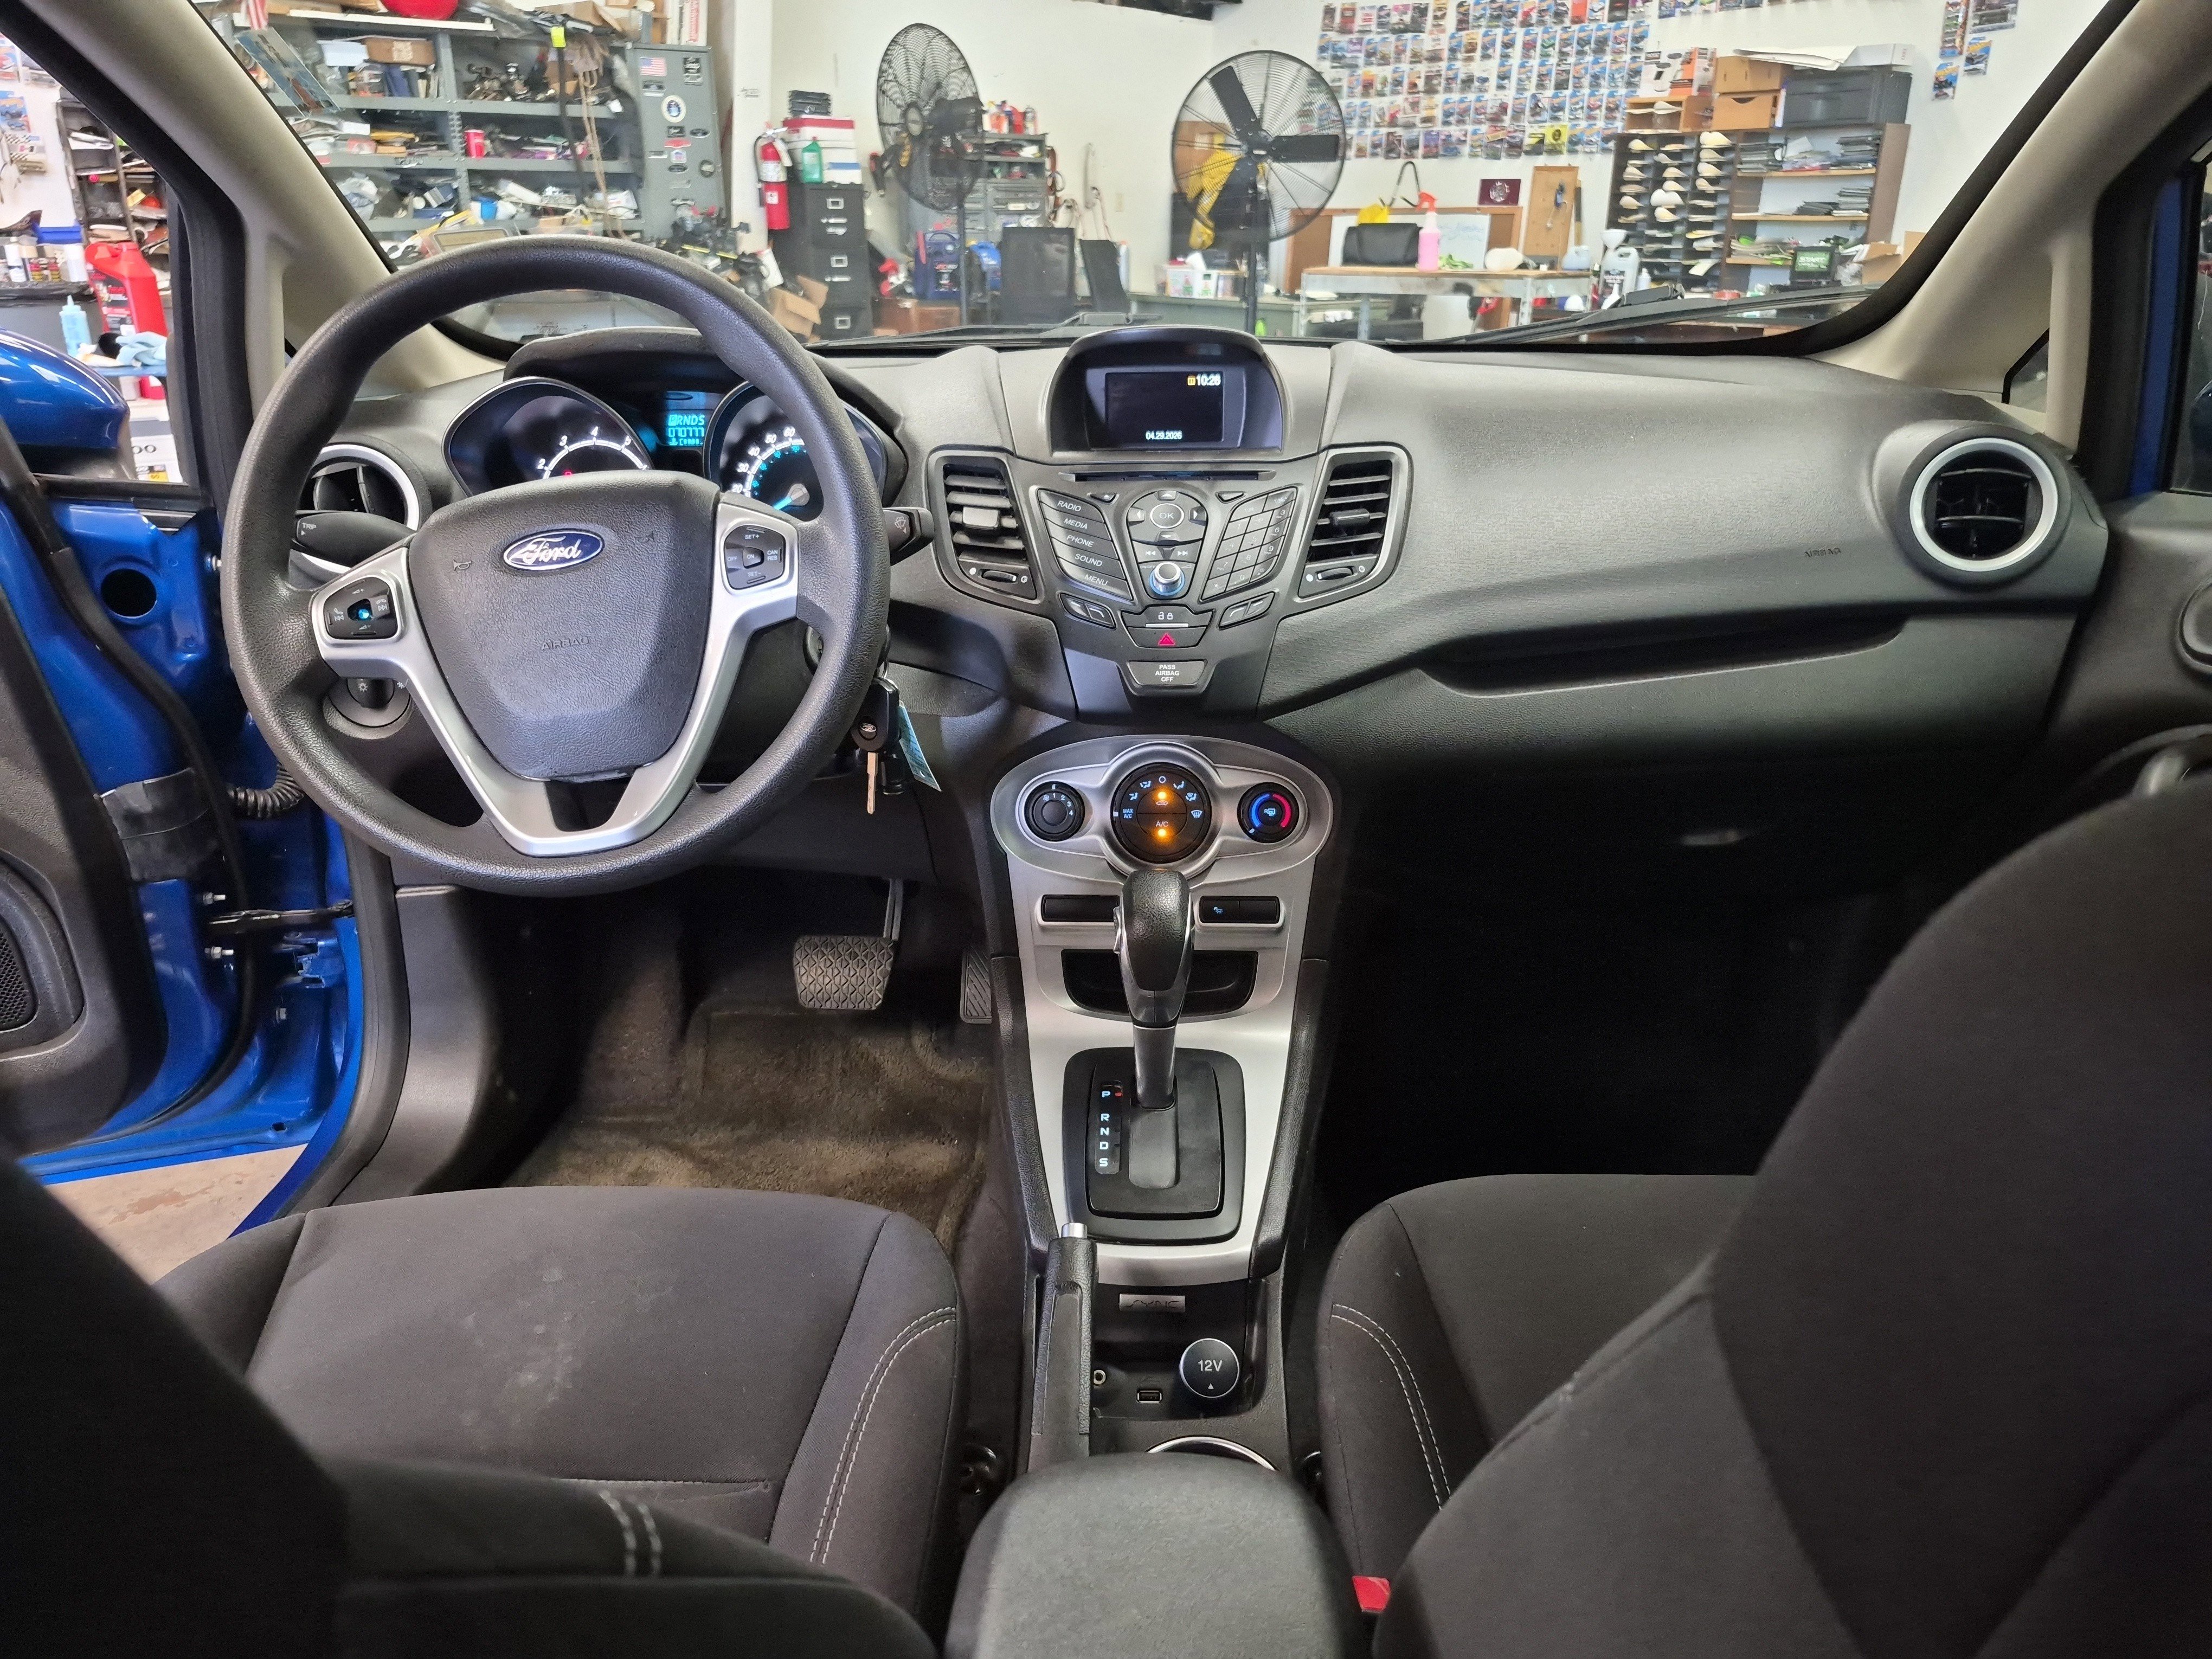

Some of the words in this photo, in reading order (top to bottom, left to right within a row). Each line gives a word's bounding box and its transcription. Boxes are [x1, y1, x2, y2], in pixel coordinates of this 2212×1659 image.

[590, 426, 599, 436] 4
[783, 426, 795, 437] 60
[1146, 430, 1182, 440] 04.29.2026
[559, 435, 568, 446] 3
[764, 433, 777, 443] 50
[748, 446, 760, 456] 40
[537, 458, 546, 470] 2
[736, 461, 749, 473] 30
[731, 483, 743, 493] 20
[1057, 500, 1082, 512] RADIO
[1064, 518, 1088, 530] MEDIA
[1066, 535, 1094, 548] PHONE
[509, 536, 582, 565] Ford
[1075, 554, 1103, 567] SOUND
[1084, 574, 1108, 586] MENU
[1101, 1113, 1110, 1121] R
[1100, 1127, 1109, 1135] N
[1099, 1141, 1109, 1150] D
[1099, 1158, 1108, 1167] S
[1198, 1359, 1223, 1372] 12V
